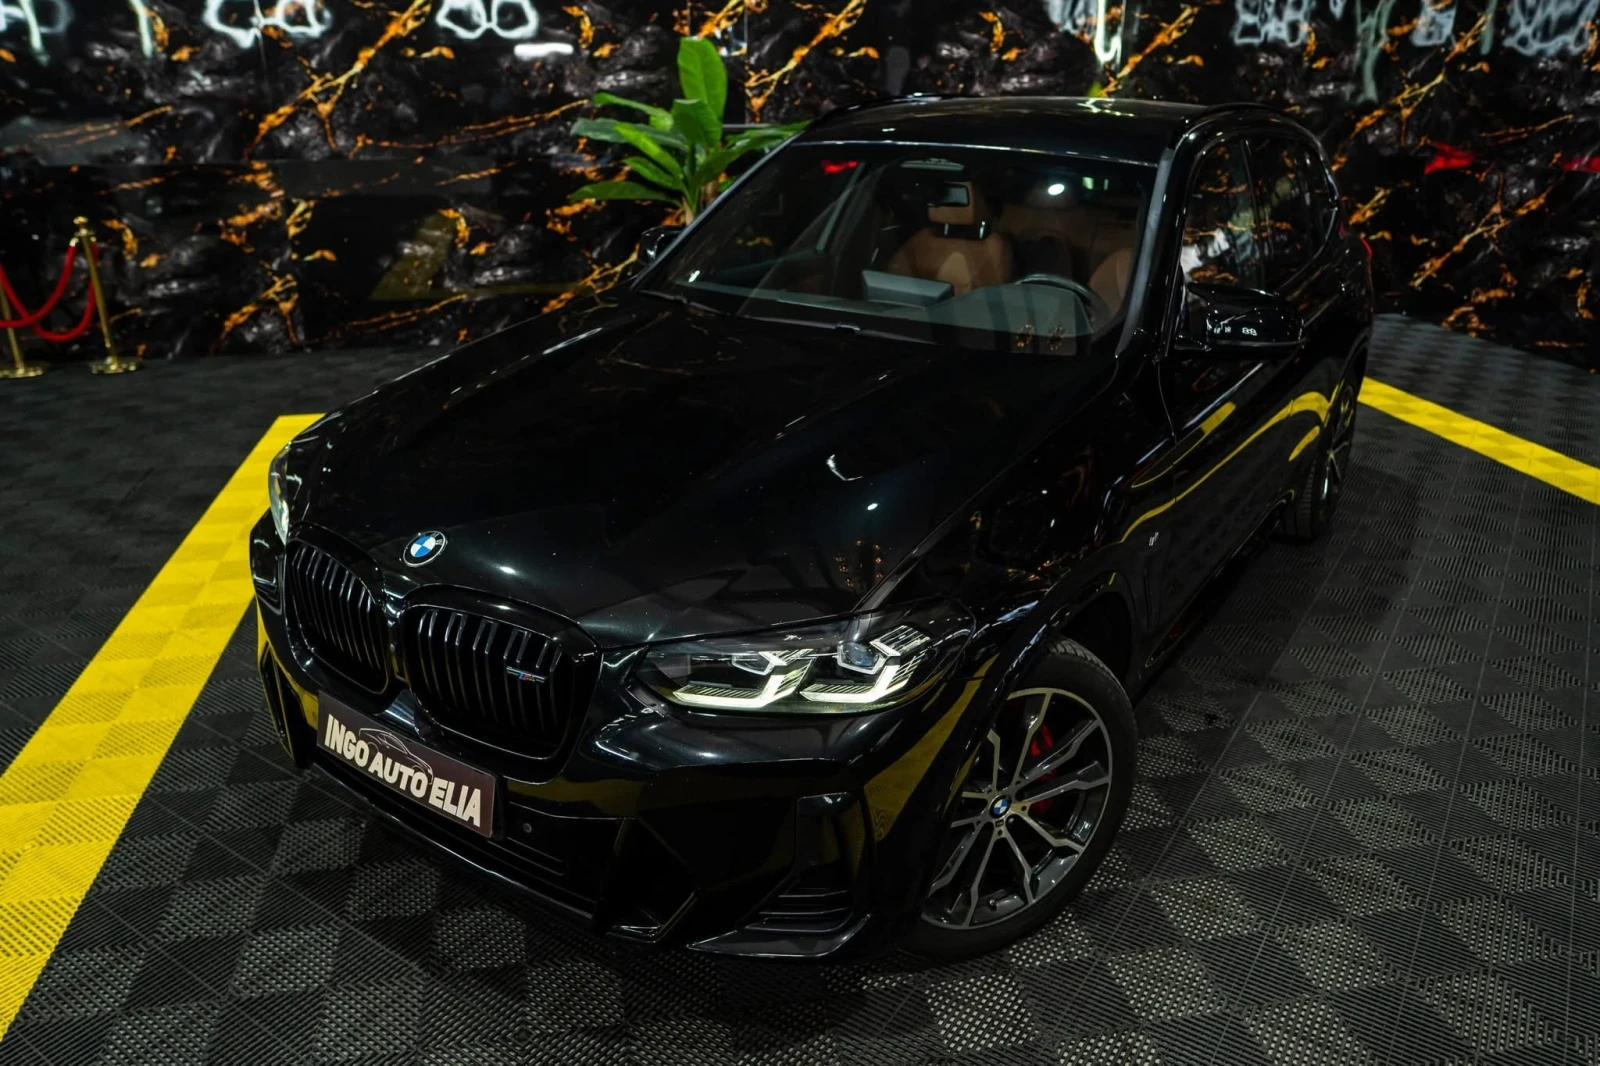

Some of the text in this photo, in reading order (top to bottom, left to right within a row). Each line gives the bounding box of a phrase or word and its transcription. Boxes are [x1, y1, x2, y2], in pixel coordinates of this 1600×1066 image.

[325, 713, 481, 827] INGO AUTO ELIA
